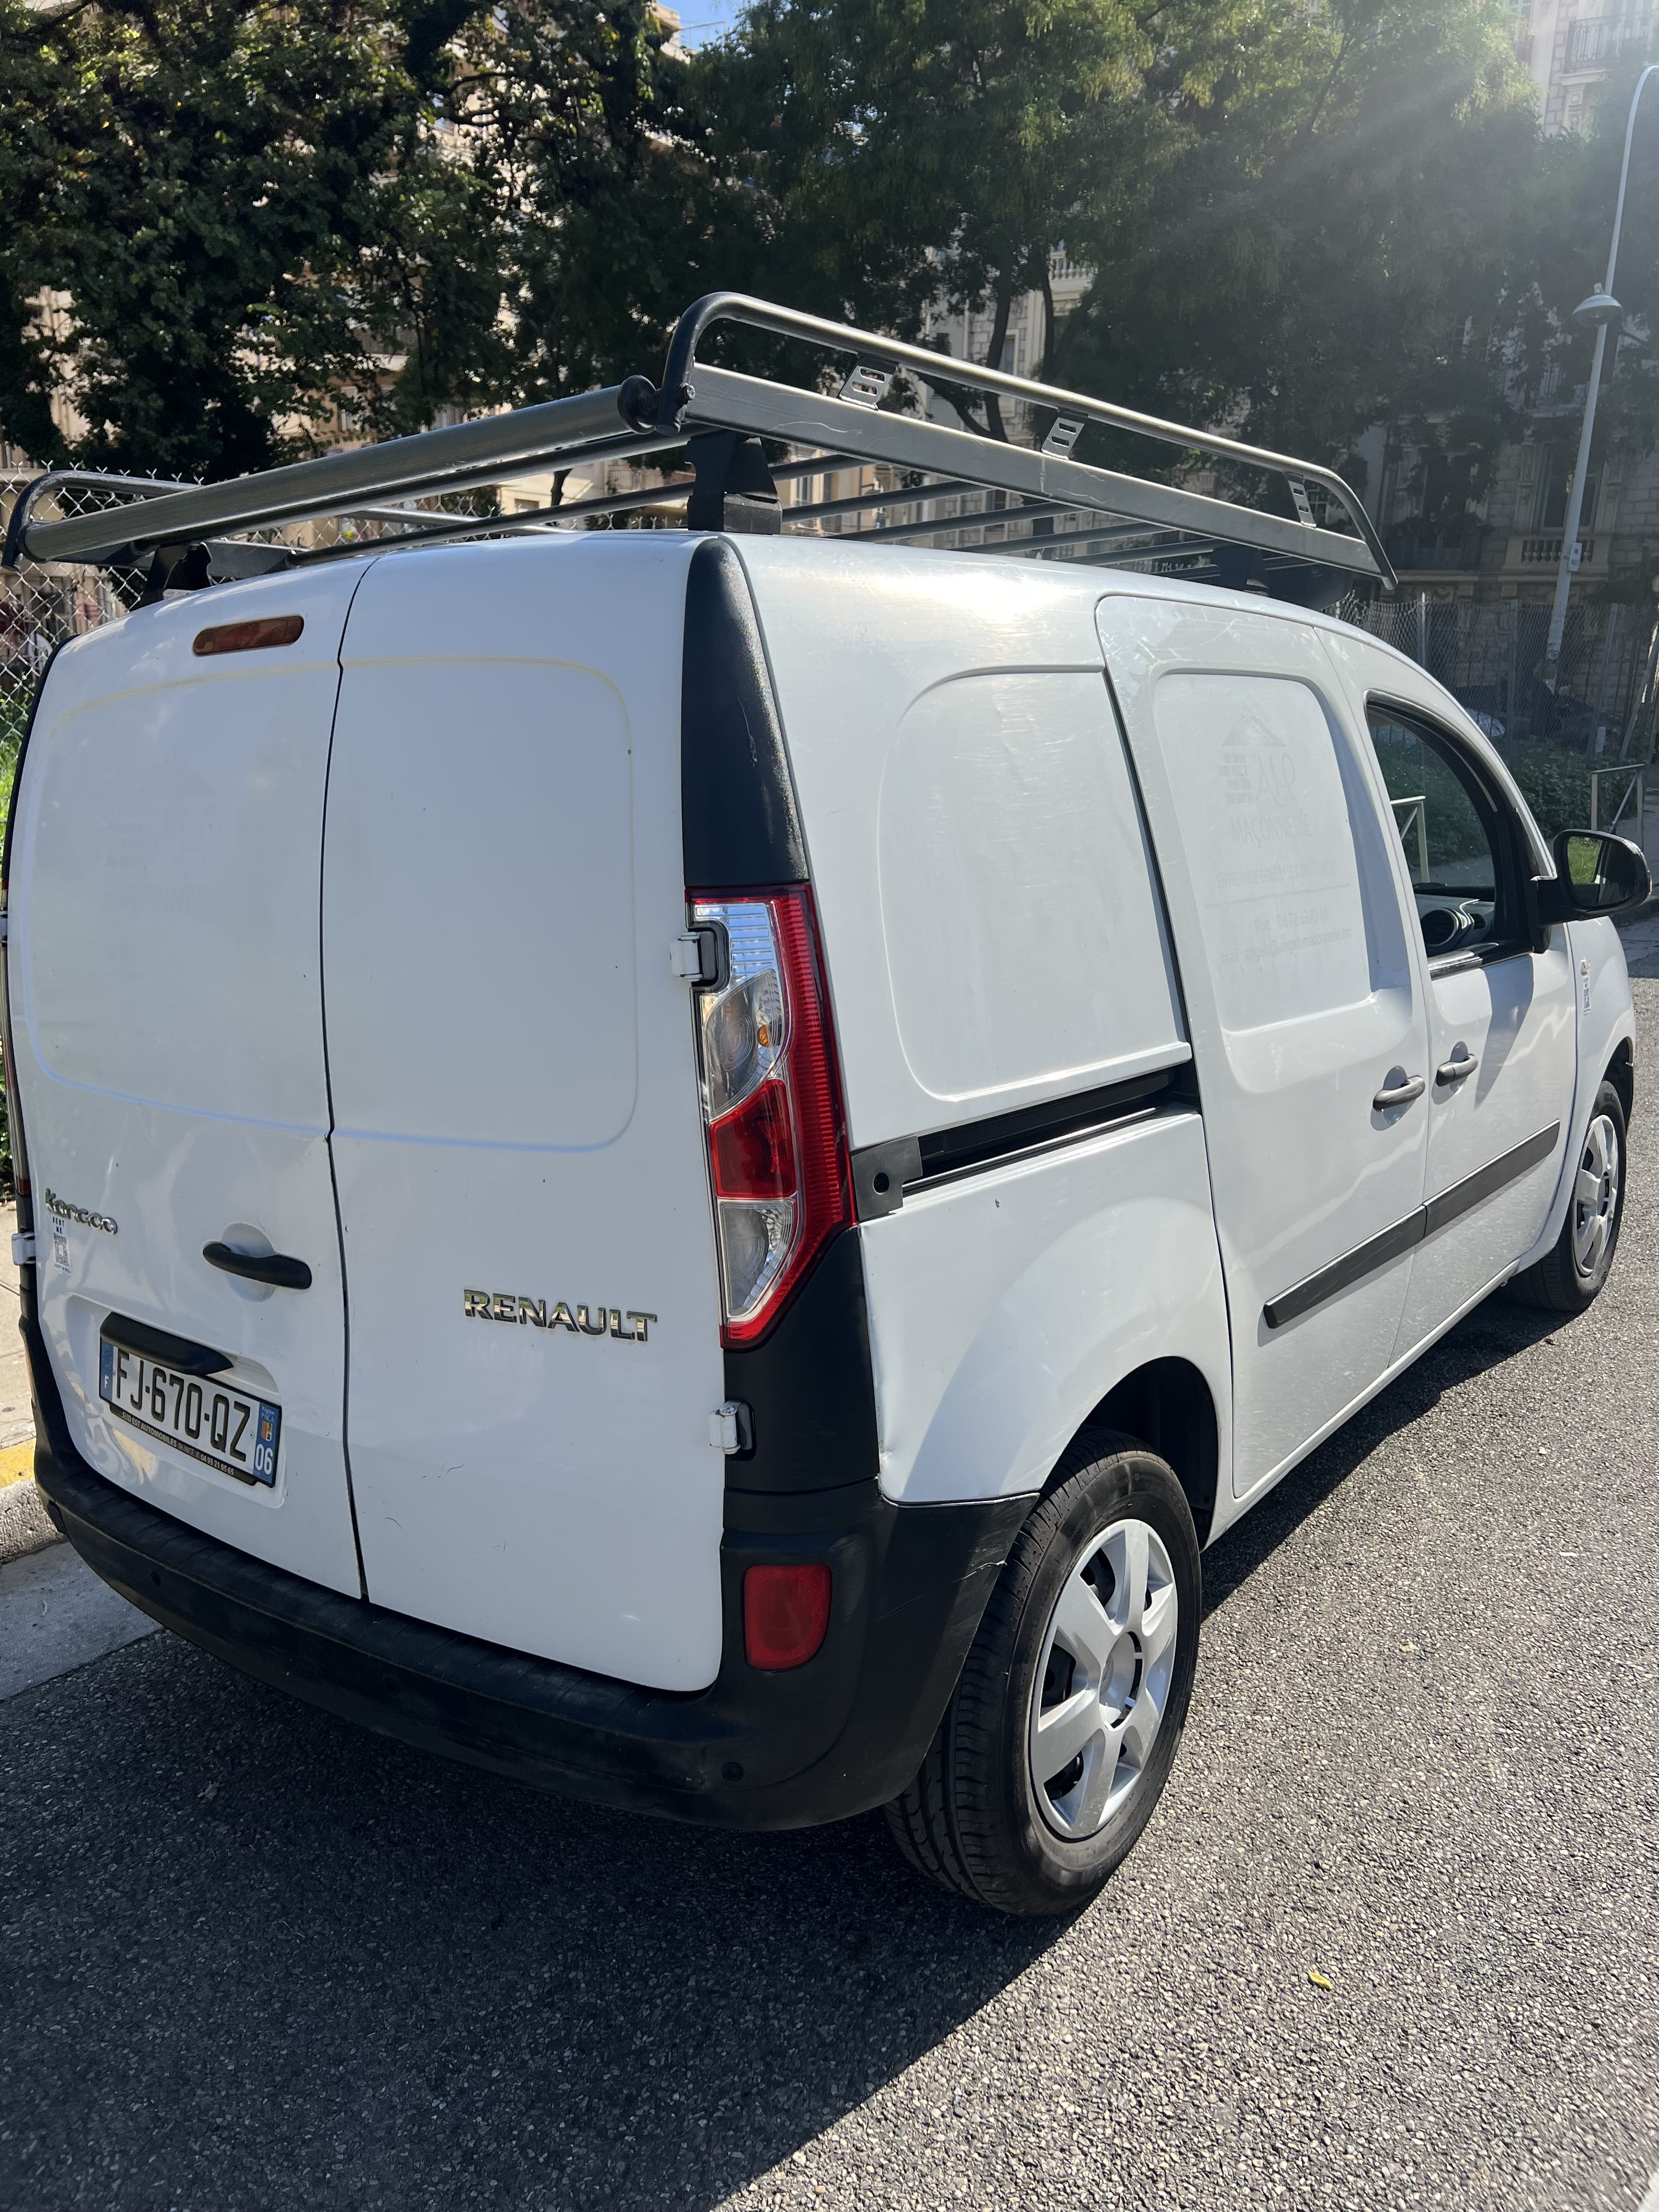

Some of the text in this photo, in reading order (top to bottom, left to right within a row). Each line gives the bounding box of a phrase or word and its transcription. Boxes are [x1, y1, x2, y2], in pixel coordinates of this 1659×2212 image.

[464, 1289, 658, 1342] RENAULT
[104, 1375, 109, 1389] F
[116, 1348, 251, 1463] FJ-670-QZ
[122, 1412, 132, 1422] SUD
[132, 1418, 141, 1427] EST
[140, 1424, 177, 1447] AUTOMOBILES
[255, 1443, 274, 1475] 06
